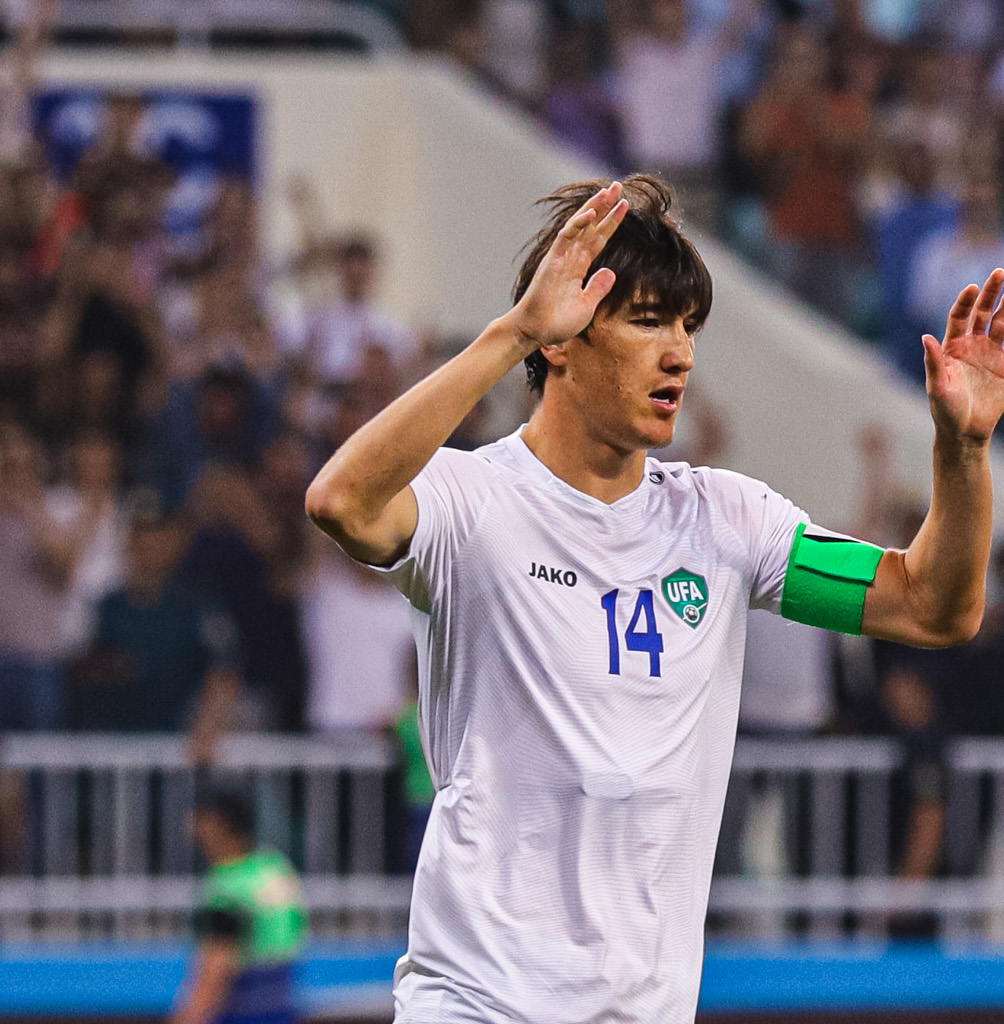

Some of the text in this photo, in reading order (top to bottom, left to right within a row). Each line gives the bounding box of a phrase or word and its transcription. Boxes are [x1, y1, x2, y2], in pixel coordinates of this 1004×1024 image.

[528, 562, 578, 588] JAKO
[666, 580, 704, 603] UFA
[600, 588, 665, 678] 14
